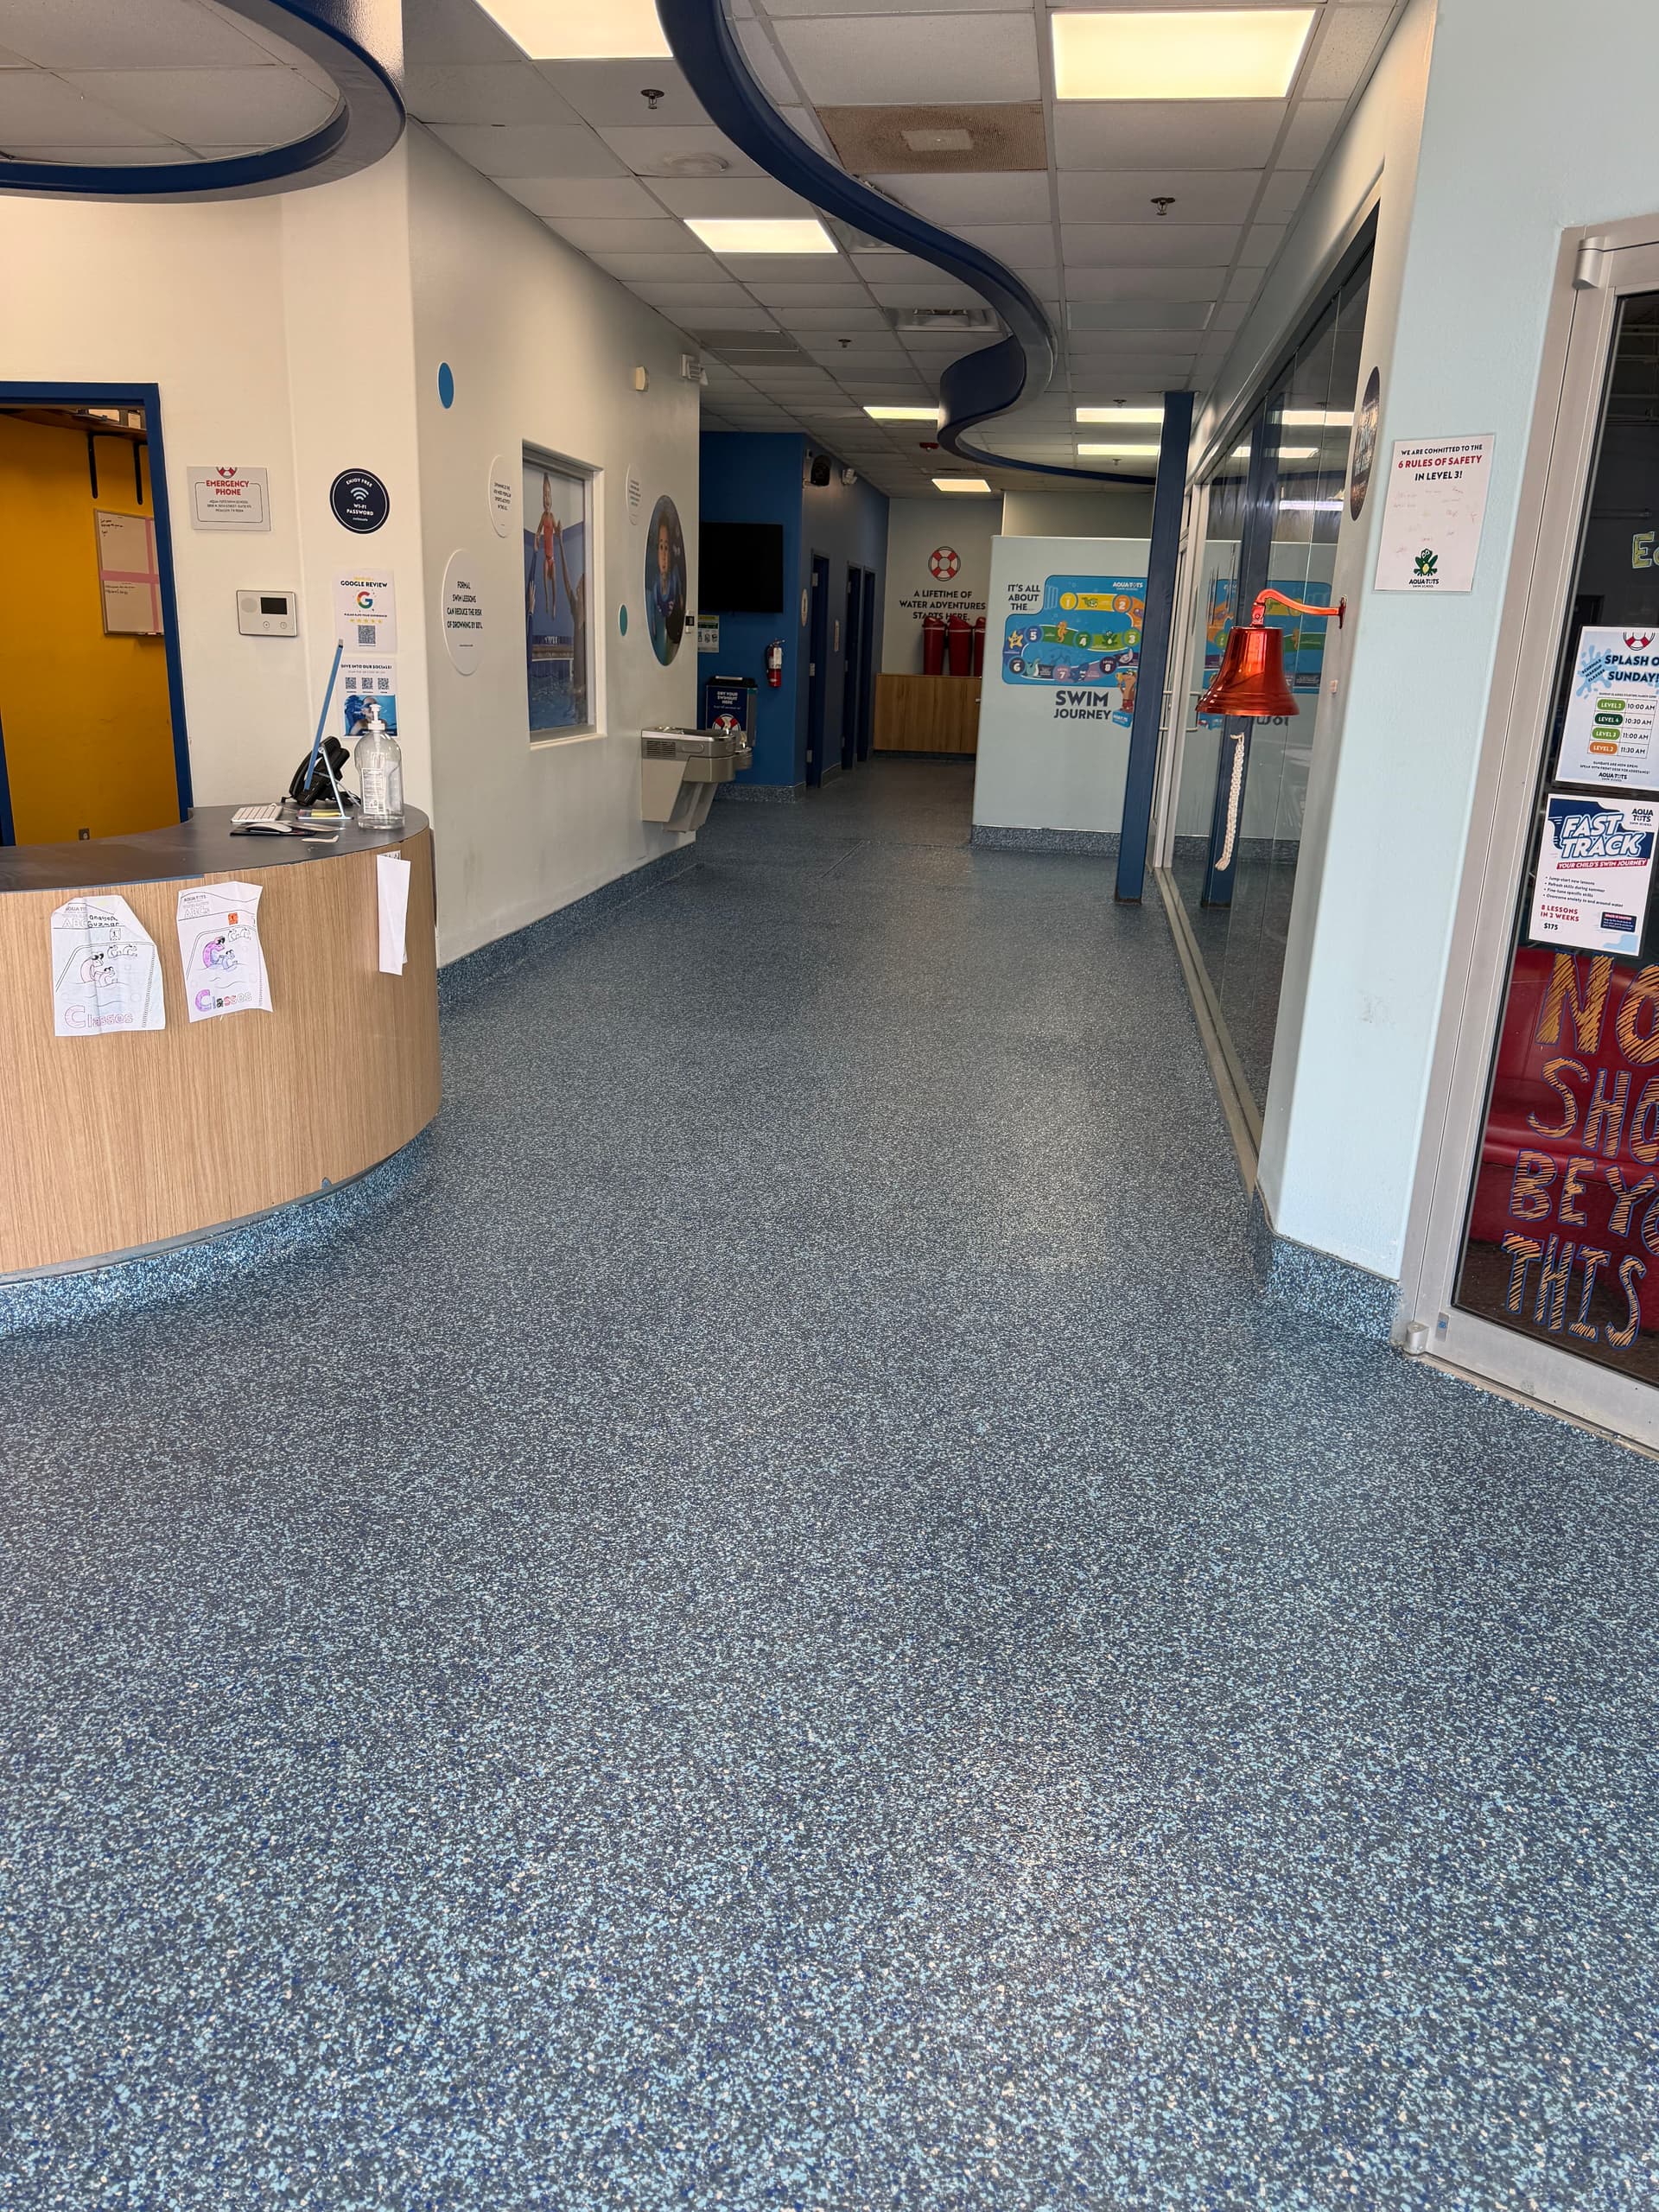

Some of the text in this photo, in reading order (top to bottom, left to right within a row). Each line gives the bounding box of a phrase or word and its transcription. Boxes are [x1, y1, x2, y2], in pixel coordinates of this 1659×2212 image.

[1405, 458, 1433, 468] RULES
[1448, 454, 1483, 465] SAFETY
[1415, 473, 1424, 481] IN
[1427, 472, 1452, 480] LEVEL
[930, 601, 986, 610] ADVENTURES
[1030, 632, 1037, 640] 5
[1128, 635, 1135, 644] 3
[1605, 655, 1649, 666] SPLASH
[1056, 690, 1109, 707] SWIM
[1053, 709, 1111, 720] JOURNEY
[1561, 814, 1624, 838] FAST
[1560, 833, 1645, 859] TRACK
[1547, 905, 1578, 914] LESSONS
[1554, 912, 1580, 922] WEEKS
[195, 989, 252, 1012] Classes
[1535, 949, 1659, 1067] NO
[64, 1004, 133, 1028] Classes
[1500, 1230, 1647, 1350] THIS
